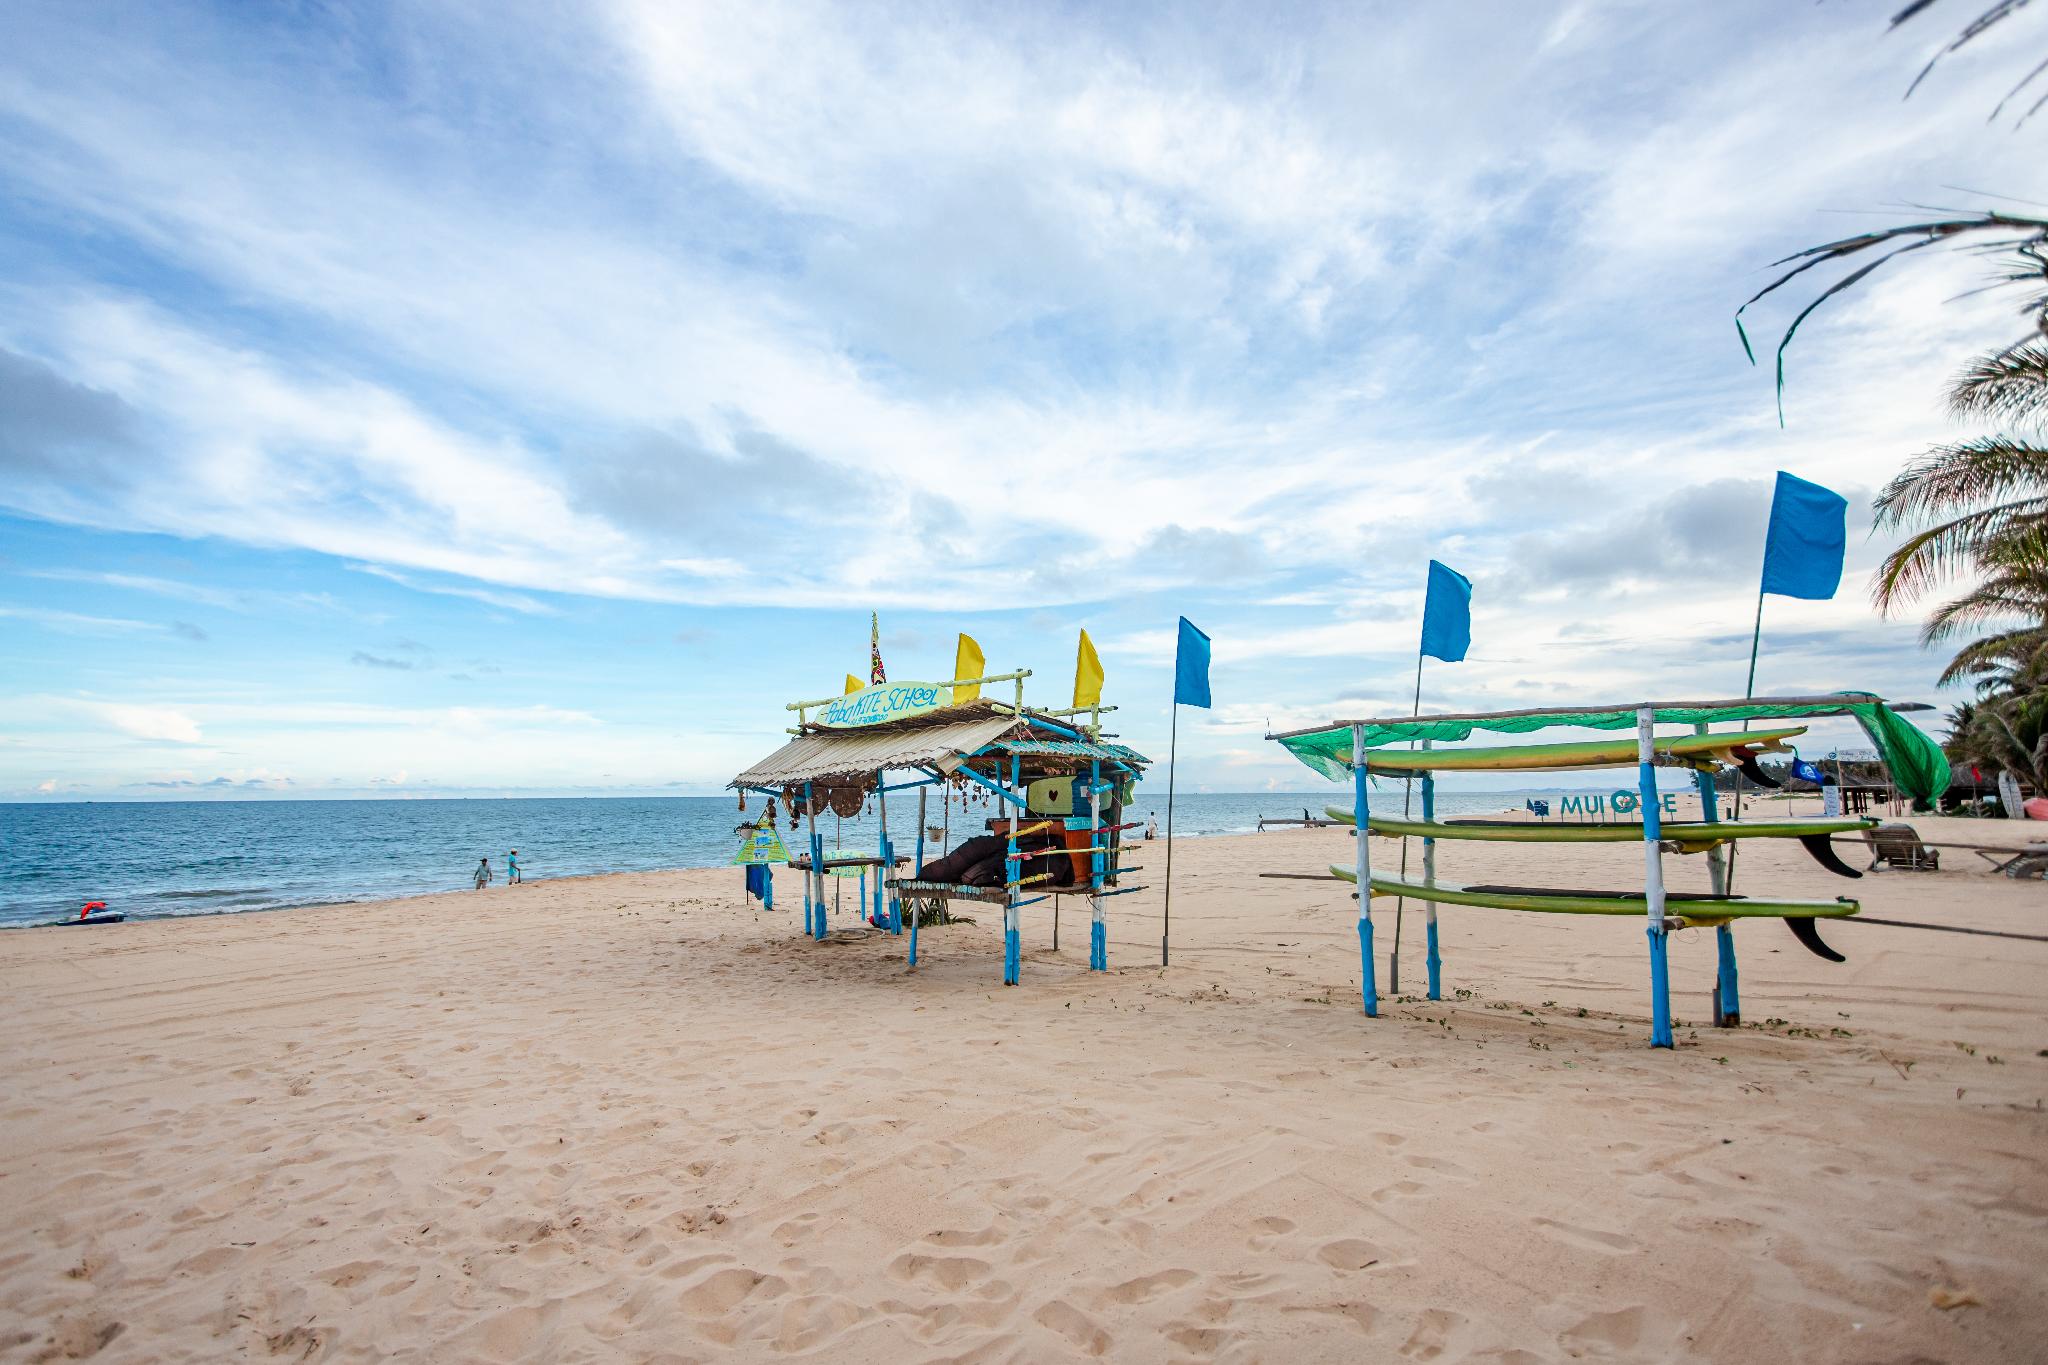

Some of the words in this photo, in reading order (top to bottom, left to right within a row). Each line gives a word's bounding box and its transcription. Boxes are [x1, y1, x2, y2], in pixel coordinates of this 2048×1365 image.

[853, 690, 886, 716] KITE
[883, 687, 938, 712] SCHOOL
[1560, 795, 1604, 814] MUI
